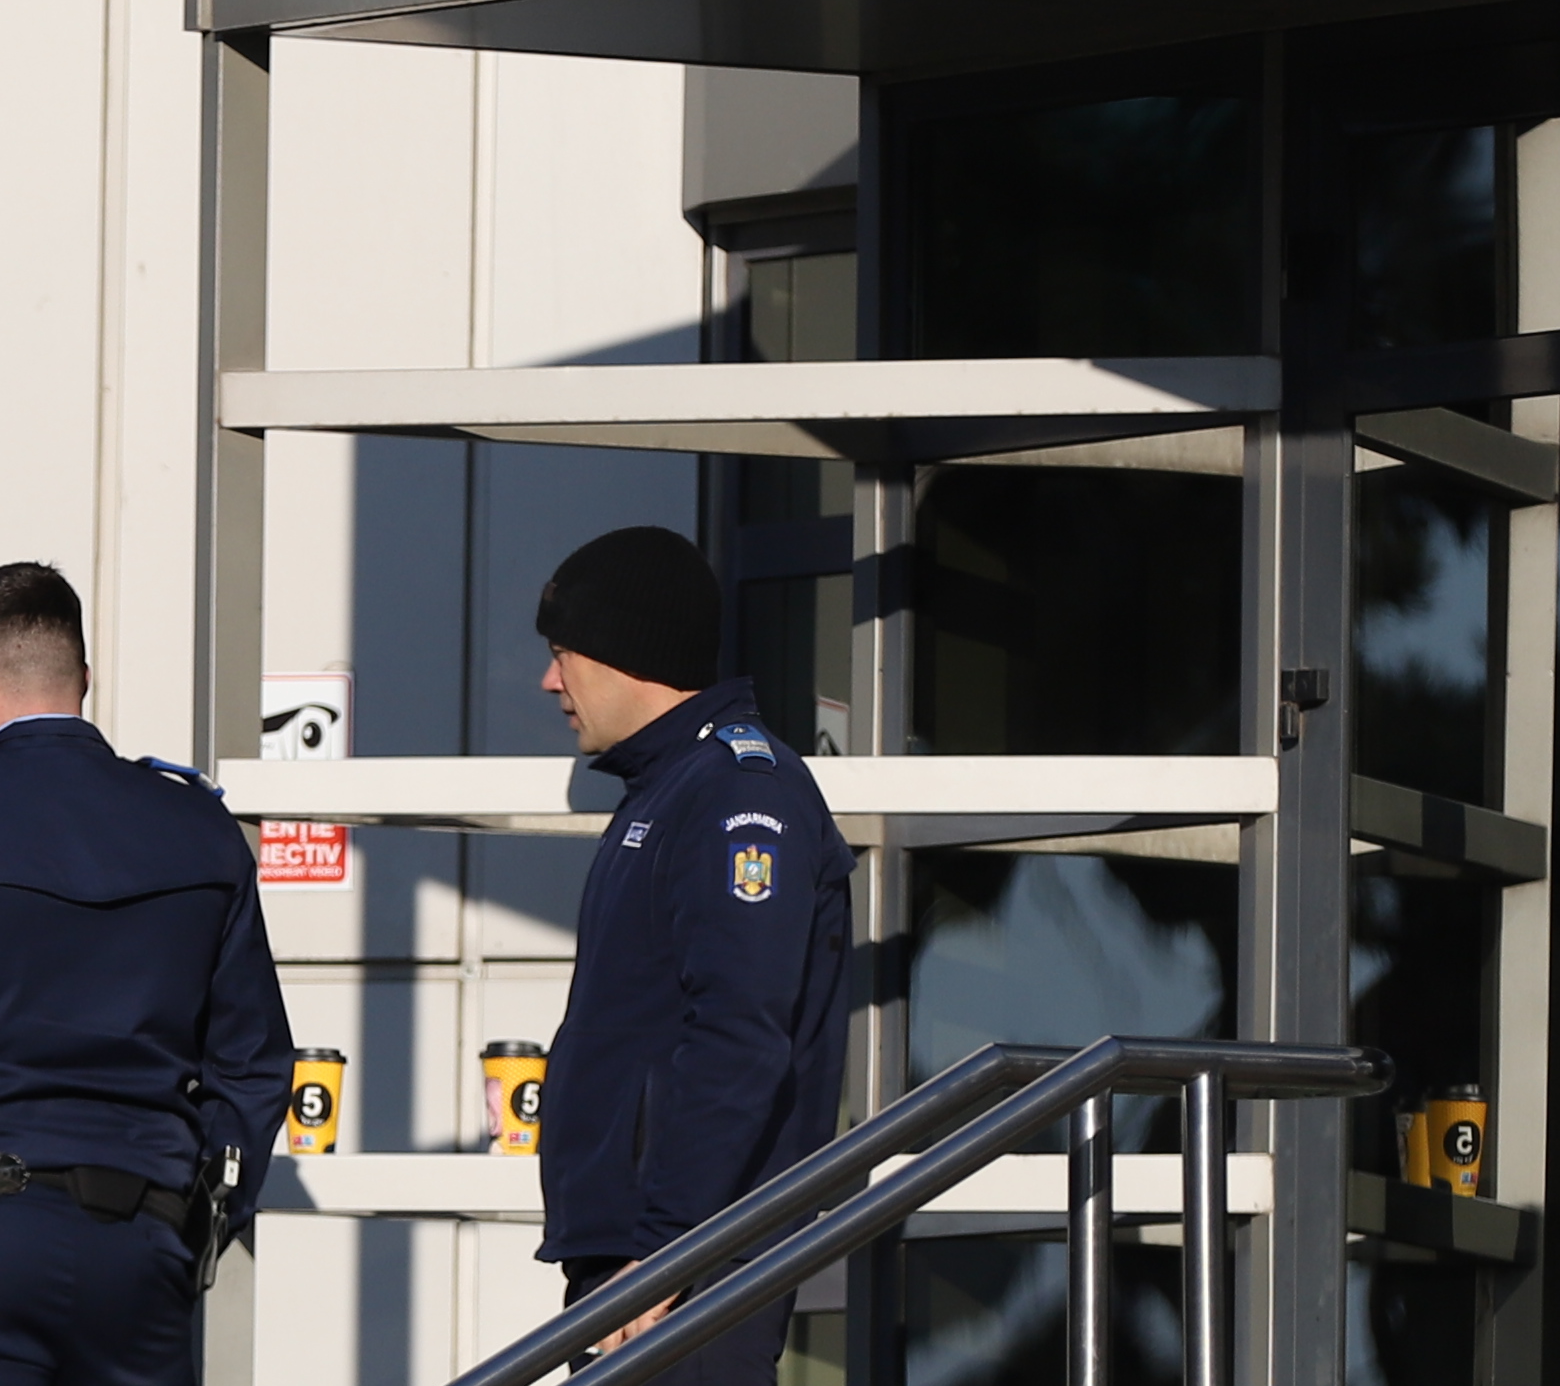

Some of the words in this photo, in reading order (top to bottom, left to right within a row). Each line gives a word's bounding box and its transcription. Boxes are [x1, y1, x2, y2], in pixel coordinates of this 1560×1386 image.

[260, 842, 342, 865] IECTIV
[301, 1085, 324, 1119] 5
[521, 1082, 541, 1115] 5
